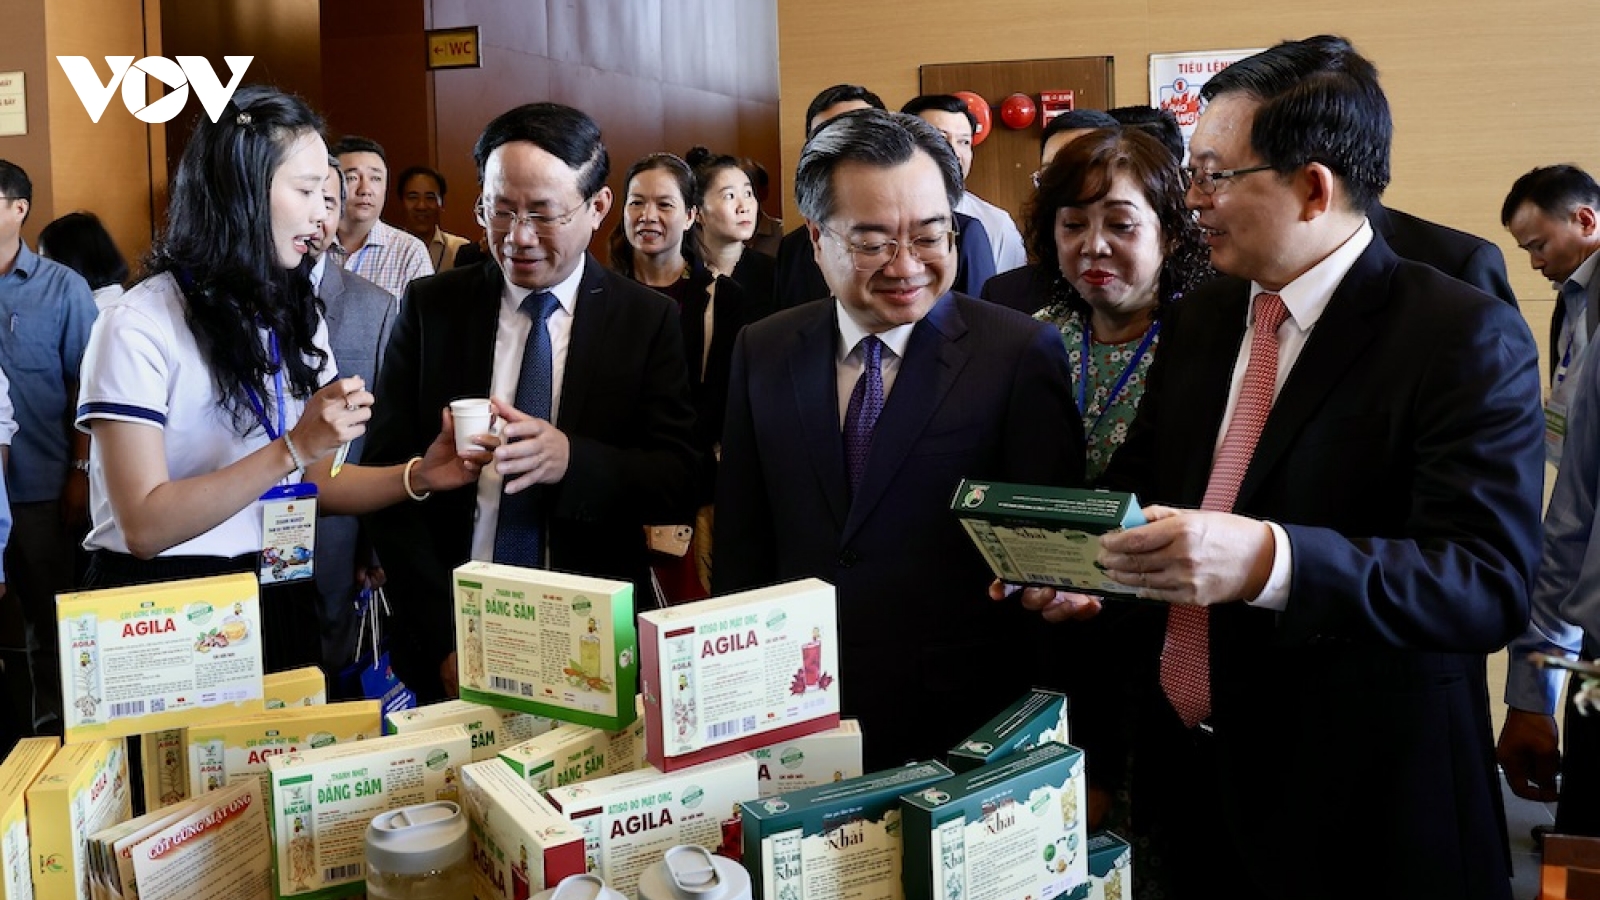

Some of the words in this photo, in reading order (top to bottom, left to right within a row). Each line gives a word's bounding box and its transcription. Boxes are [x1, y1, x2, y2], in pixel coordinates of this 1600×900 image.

[449, 40, 472, 56] WC
[121, 617, 176, 638] AGILA
[701, 630, 759, 659] AGILA
[471, 730, 495, 749] SÂM
[355, 777, 382, 797] SÂM
[610, 808, 673, 840] AGILA
